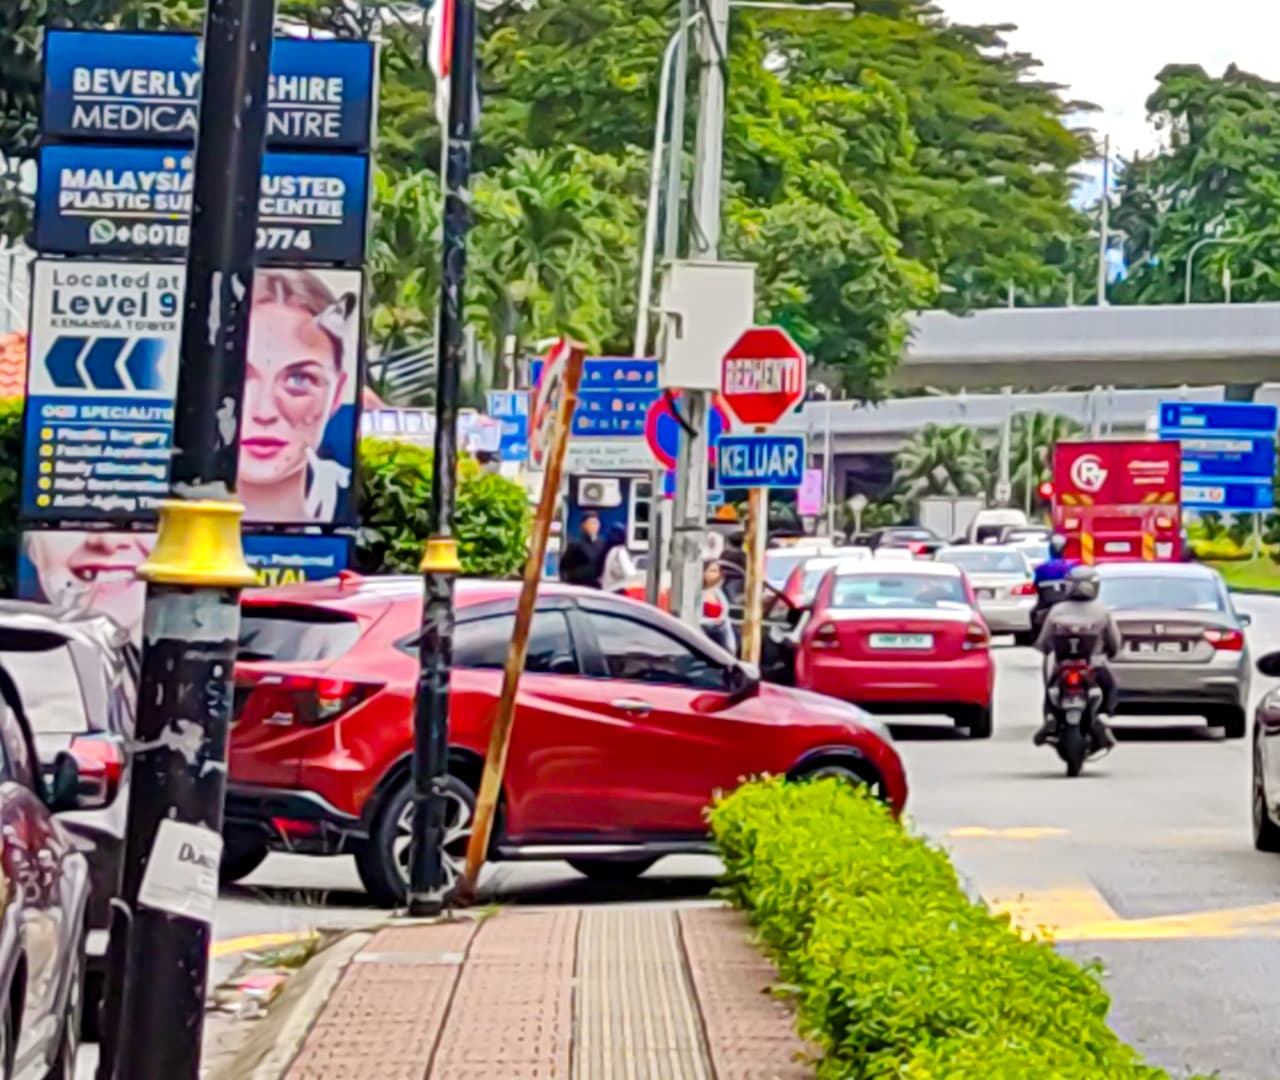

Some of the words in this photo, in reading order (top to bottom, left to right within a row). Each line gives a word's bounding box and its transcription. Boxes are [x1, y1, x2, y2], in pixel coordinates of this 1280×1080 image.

[73, 67, 200, 97] BEVERLY
[71, 103, 198, 133] MEDICA
[266, 111, 342, 138] NTRE
[59, 191, 151, 210] PLASTIC
[258, 197, 344, 217] CENTRE
[52, 270, 150, 290] Located
[156, 276, 180, 290] at
[51, 289, 148, 318] Level
[159, 291, 178, 318] 9
[721, 443, 799, 479] KELUAR
